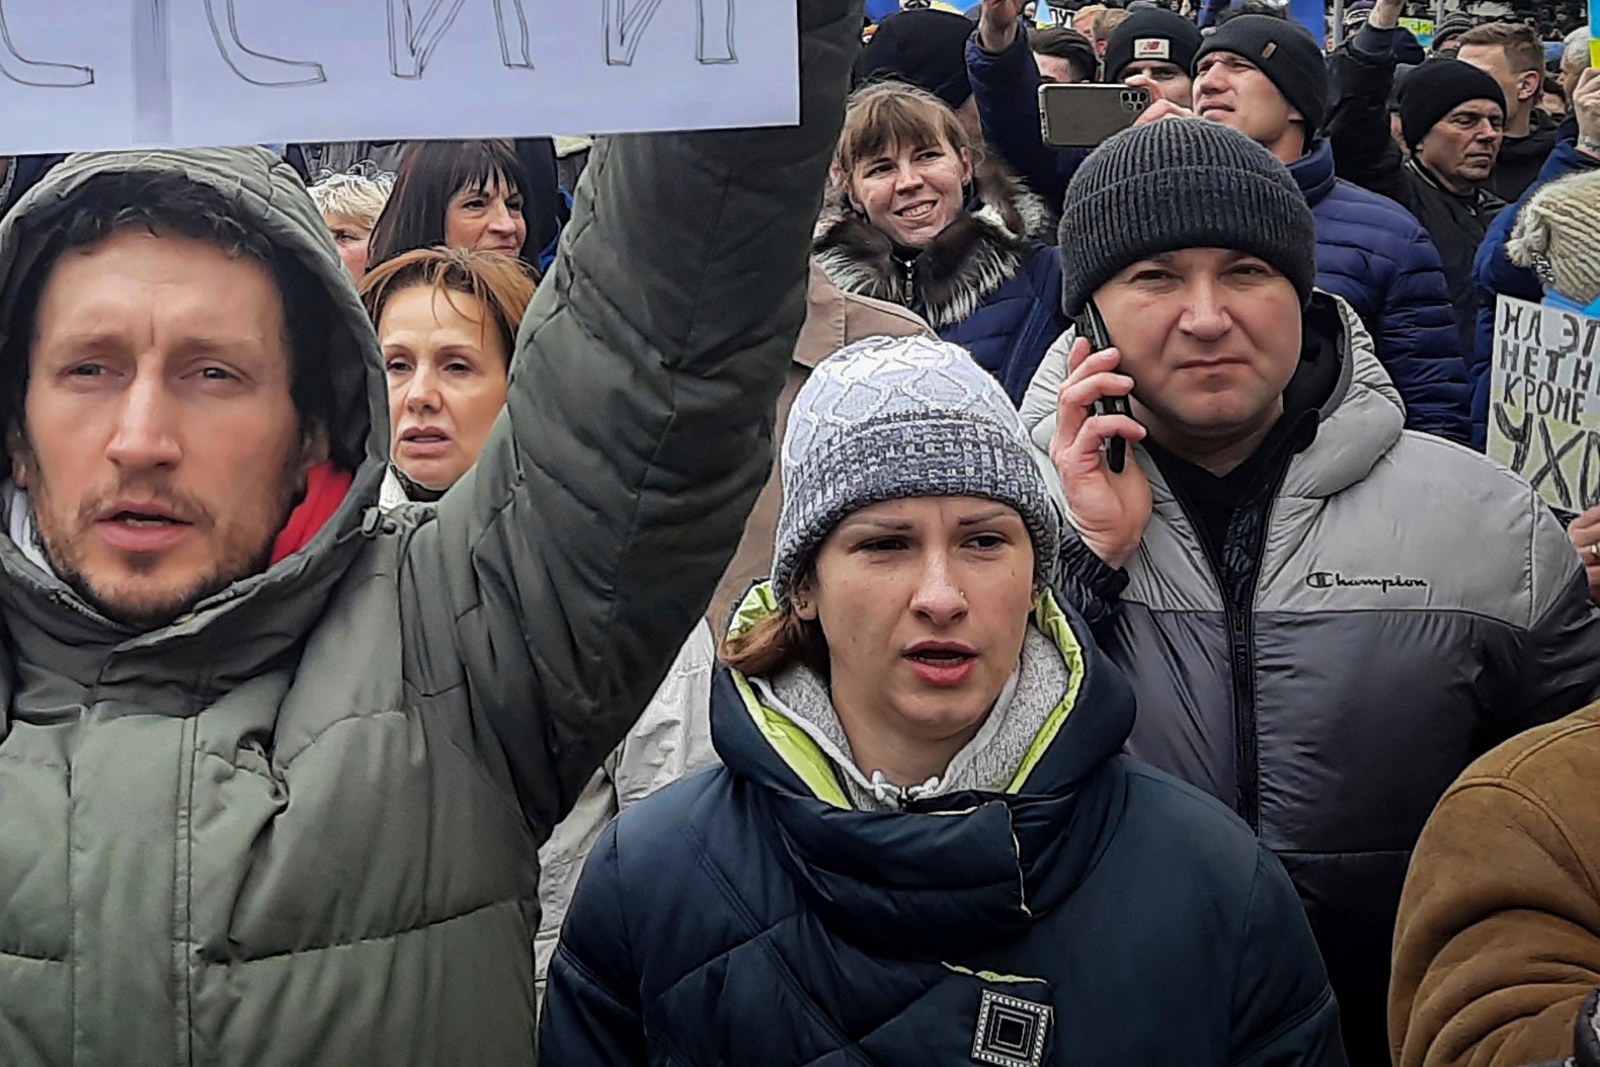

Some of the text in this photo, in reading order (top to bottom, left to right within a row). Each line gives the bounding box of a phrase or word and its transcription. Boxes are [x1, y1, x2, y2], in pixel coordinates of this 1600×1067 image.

[1557, 313, 1600, 358] ЭТ
[1500, 339, 1600, 397] НЕТ Н
[1504, 373, 1586, 426] КРОМЕ
[1493, 402, 1600, 510] УХО
[1306, 572, 1428, 594] Champion
